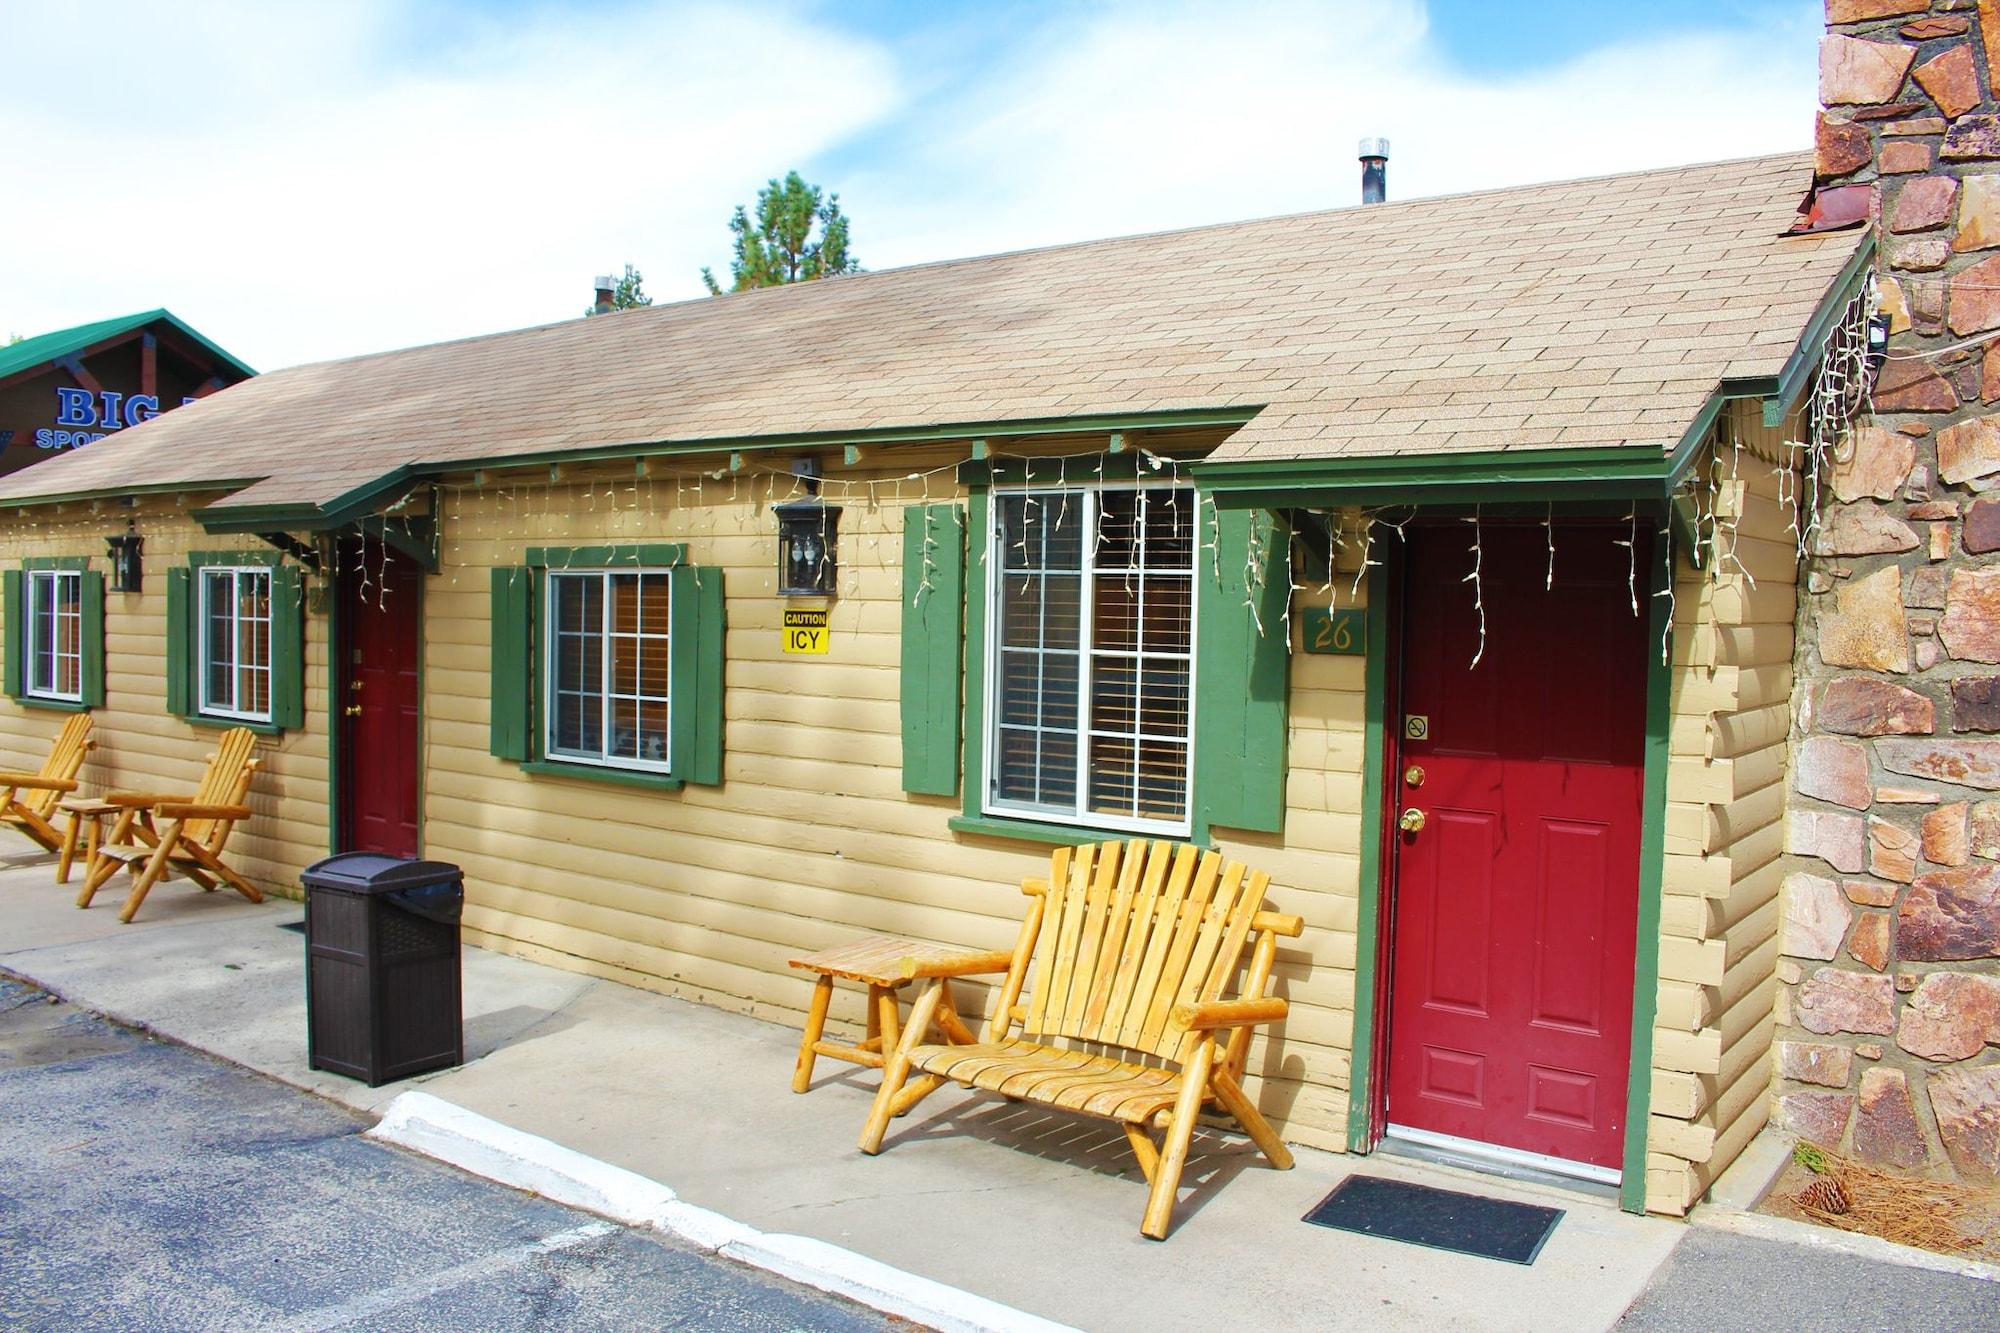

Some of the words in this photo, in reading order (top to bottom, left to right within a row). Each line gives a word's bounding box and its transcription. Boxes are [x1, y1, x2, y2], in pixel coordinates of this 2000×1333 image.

[57, 387, 161, 429] BIG
[785, 613, 826, 625] CAUTION
[1315, 615, 1352, 649] 26
[791, 630, 820, 649] ICY
